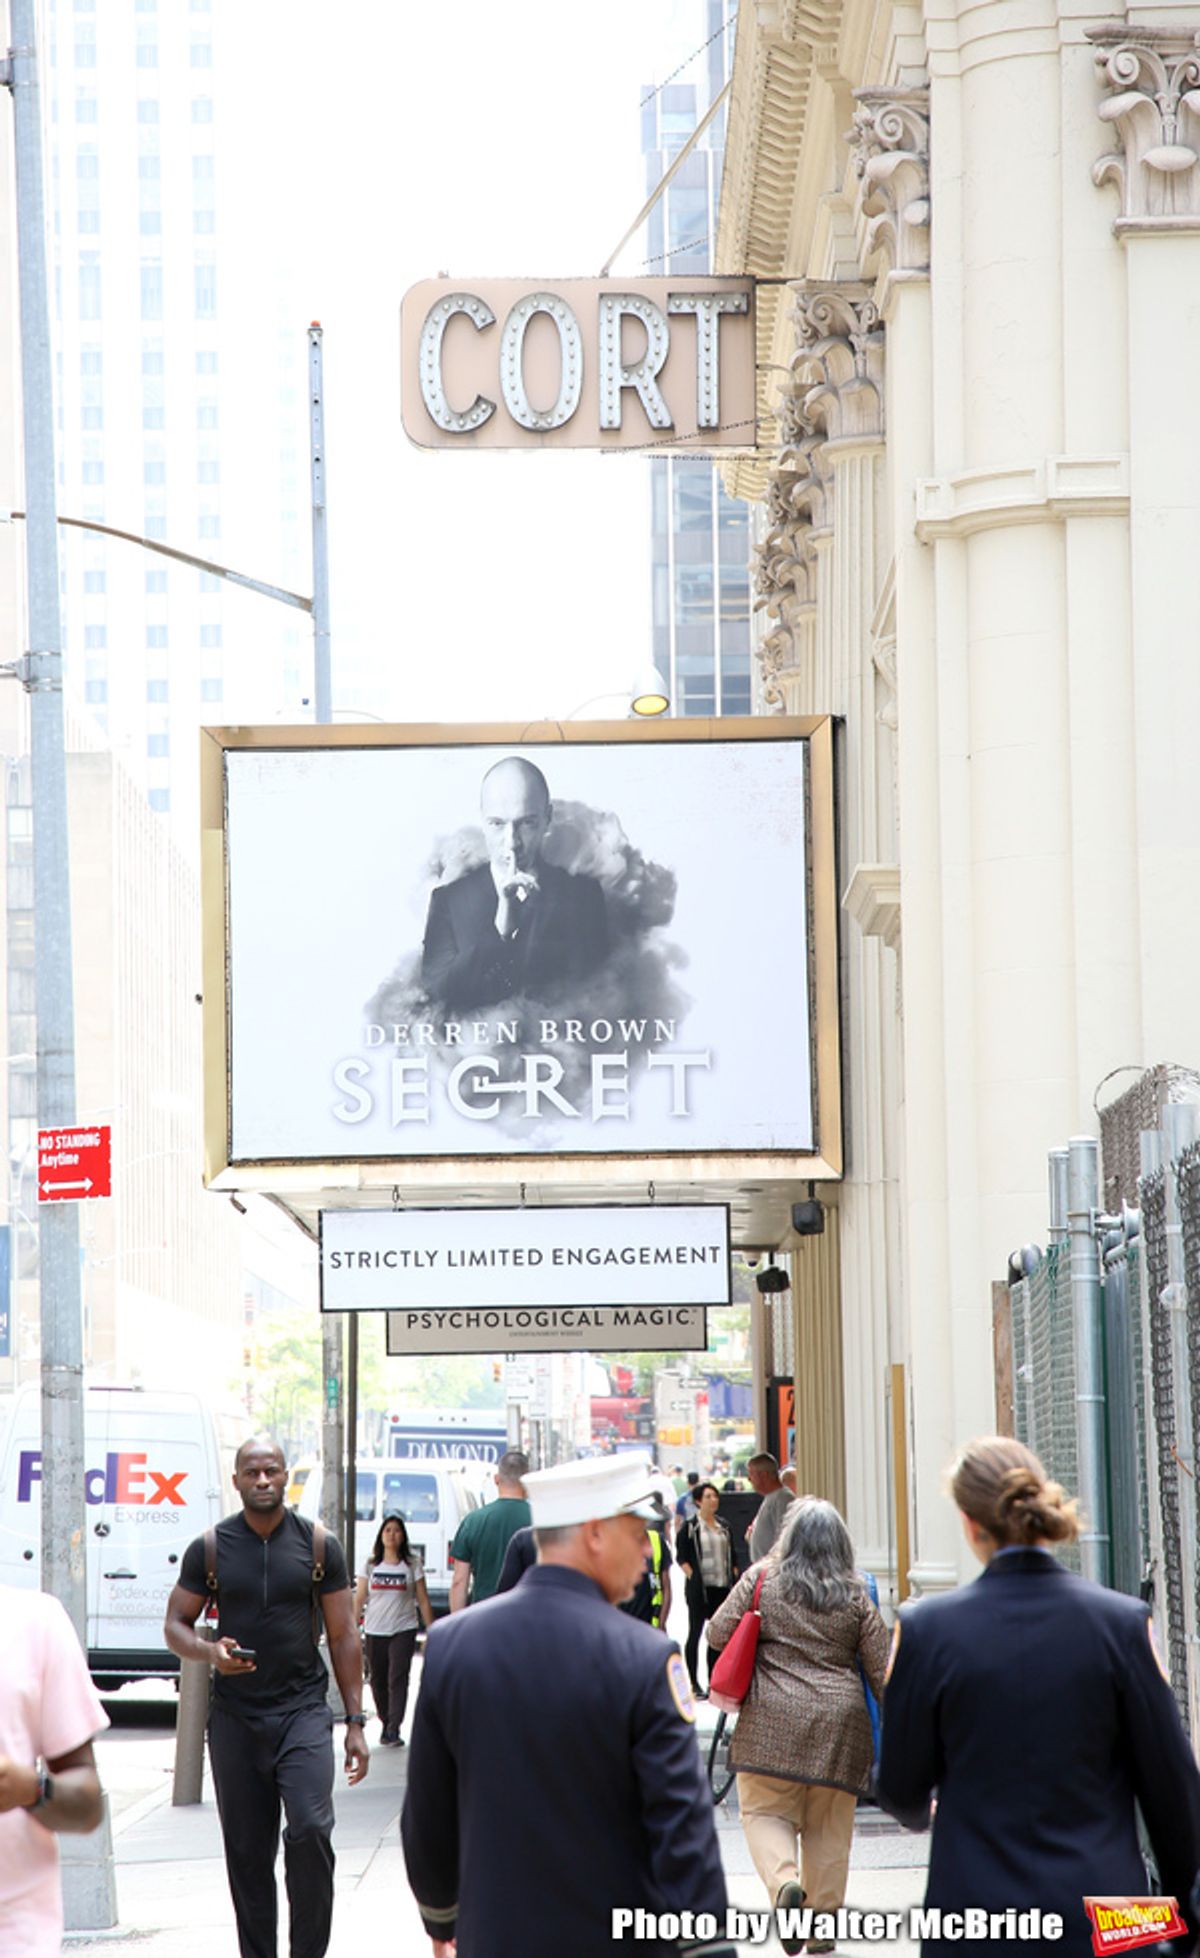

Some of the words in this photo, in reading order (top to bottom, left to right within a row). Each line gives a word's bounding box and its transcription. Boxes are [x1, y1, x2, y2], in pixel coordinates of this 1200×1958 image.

[419, 292, 749, 433] CORT
[365, 1020, 518, 1047] DERREN
[540, 1018, 676, 1043] BROWN
[332, 1049, 712, 1128] SECRET
[39, 1136, 53, 1150] NO
[56, 1132, 101, 1150] STANDING
[41, 1152, 80, 1169] Anytime
[330, 1249, 438, 1270] STRICTLY
[447, 1248, 543, 1267] LIMITED
[552, 1246, 720, 1265] ENGAGEMENT
[407, 1311, 604, 1329] PSYCHOLOGICAL
[407, 1441, 498, 1463] DIAMOND
[16, 1450, 189, 1506] FdEx
[114, 1507, 180, 1525] Express
